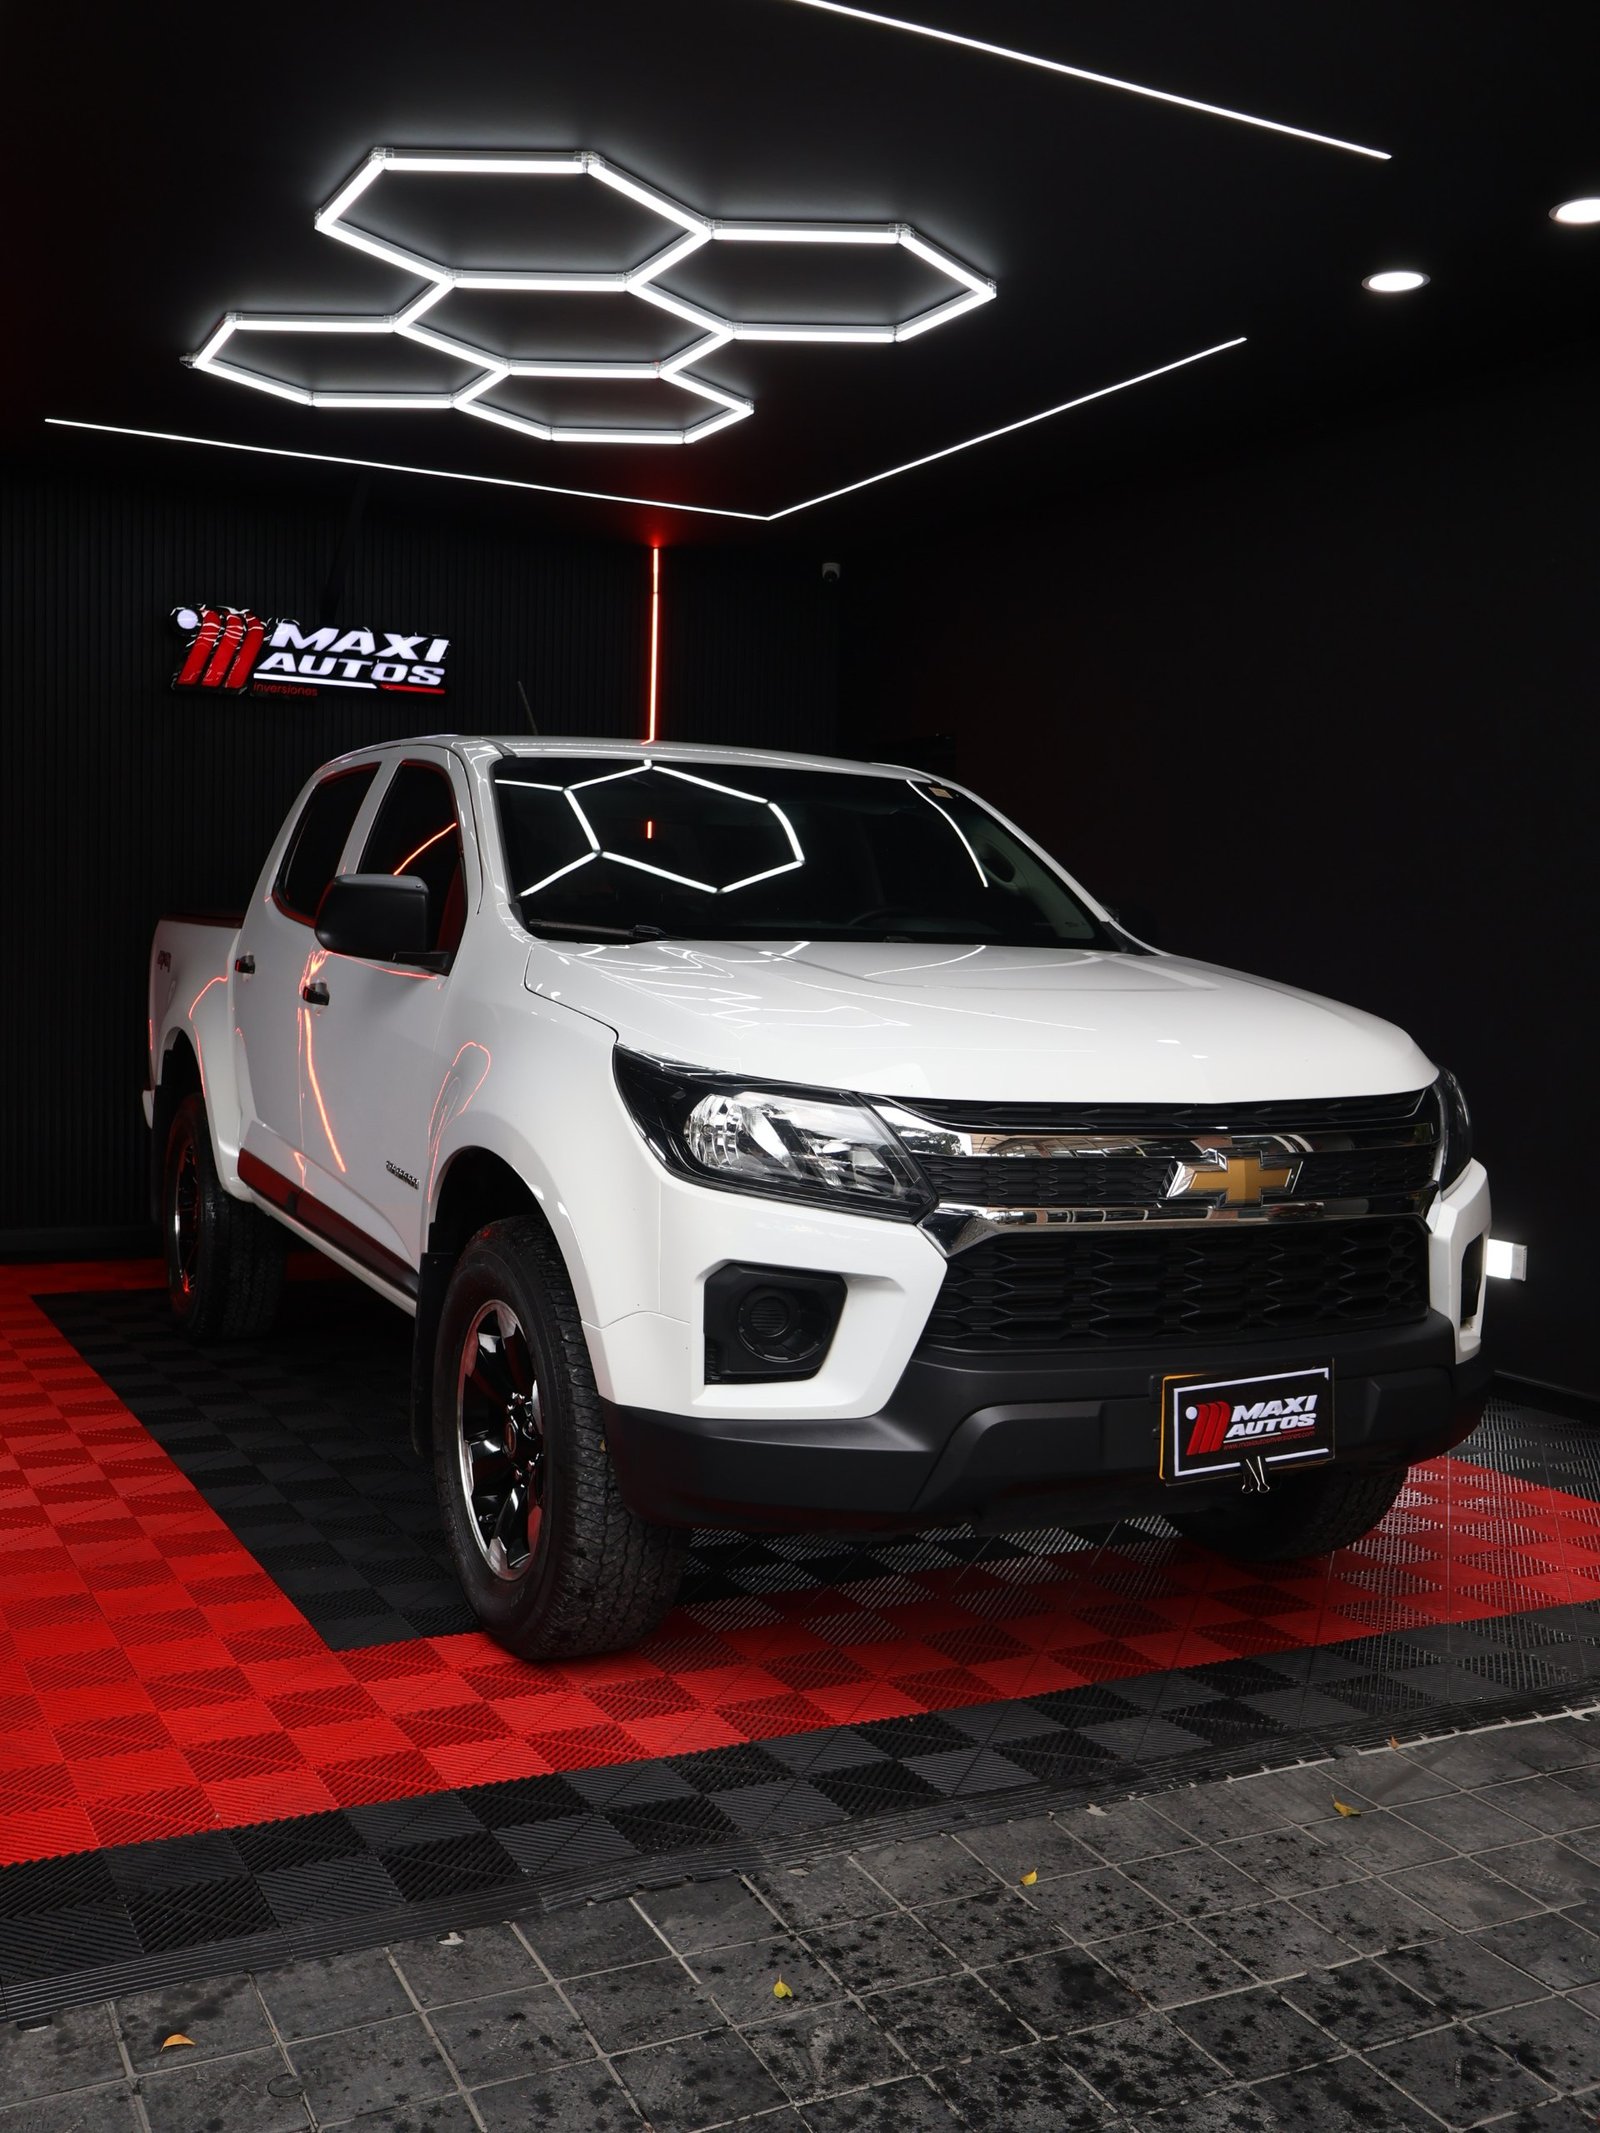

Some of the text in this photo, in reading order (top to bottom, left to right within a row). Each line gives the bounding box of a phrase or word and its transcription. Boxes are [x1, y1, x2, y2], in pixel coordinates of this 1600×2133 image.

[269, 622, 450, 663] MAXI
[257, 652, 446, 686] AUTOS
[1230, 1395, 1318, 1423] MAXI
[1225, 1413, 1317, 1438] AUTOS
